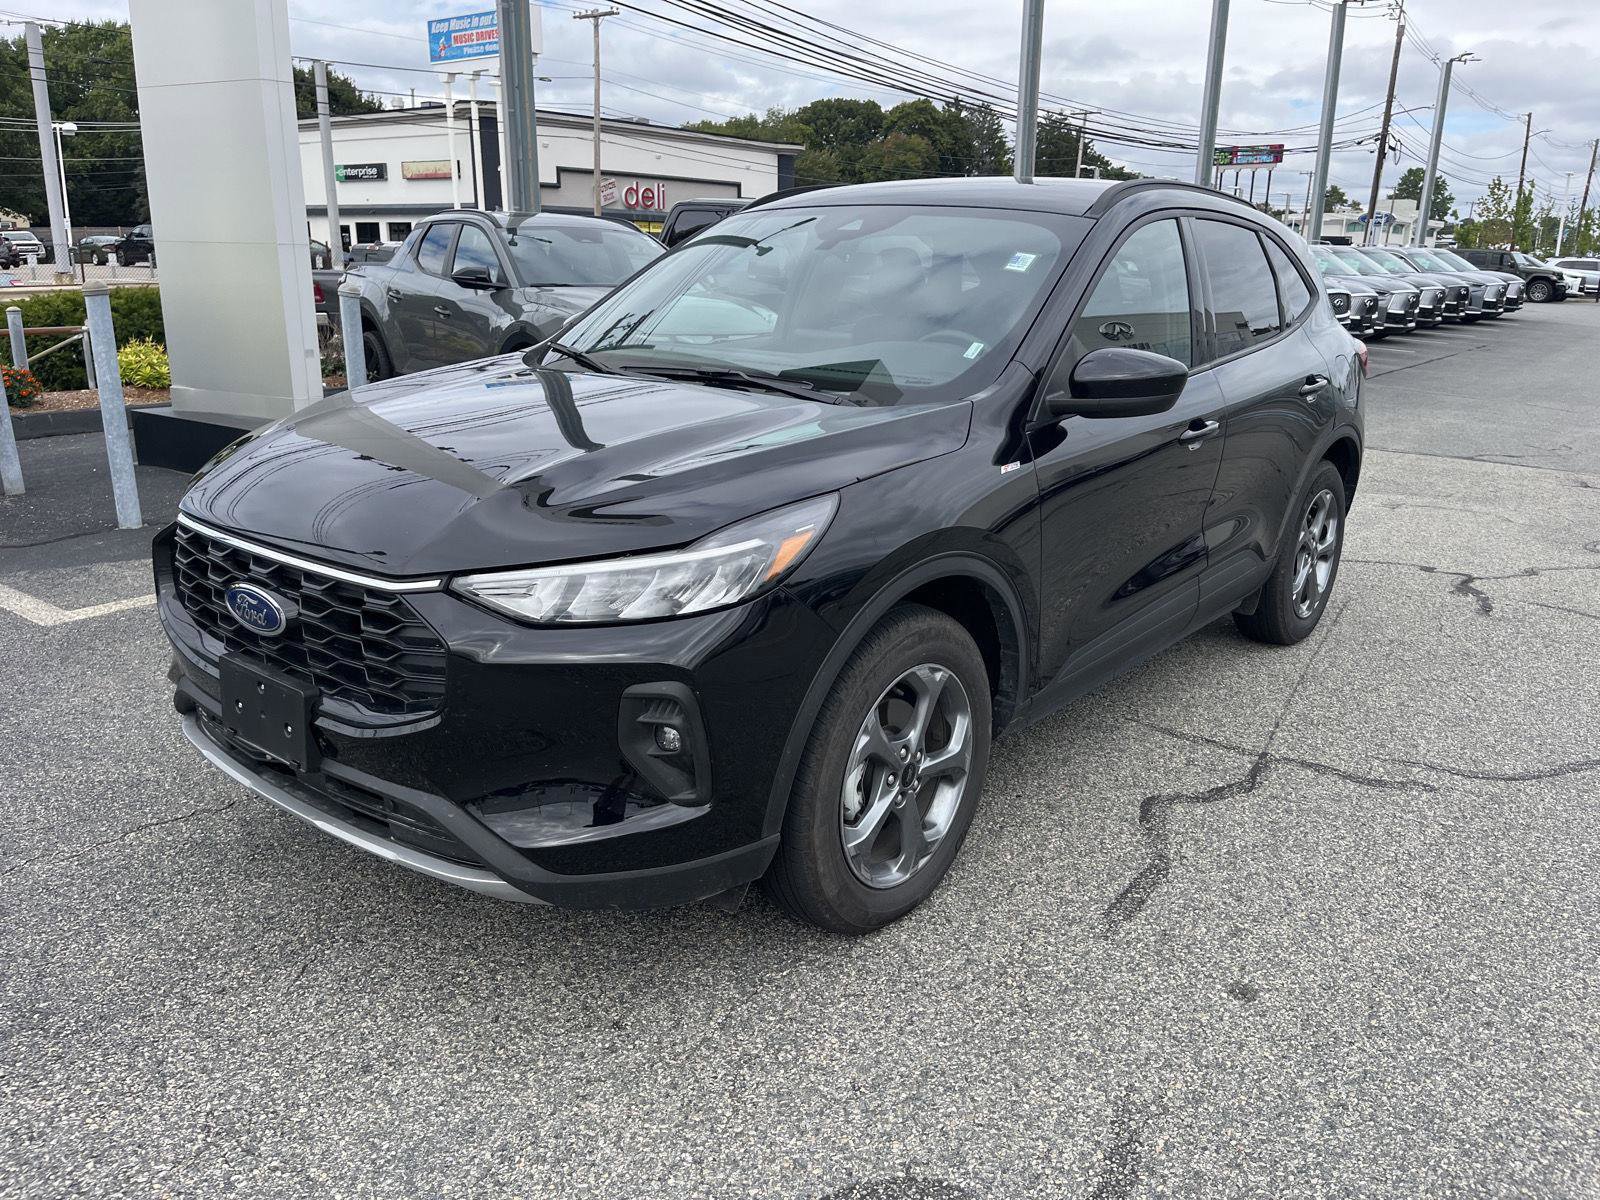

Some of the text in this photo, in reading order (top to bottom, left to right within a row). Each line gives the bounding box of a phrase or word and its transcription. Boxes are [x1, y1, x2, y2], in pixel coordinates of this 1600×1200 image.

[431, 20, 449, 33] Keep
[449, 17, 471, 30] Music
[471, 15, 480, 28] in
[480, 14, 493, 26] our
[453, 32, 475, 45] MUSIC
[337, 165, 378, 178] enterprise
[623, 181, 666, 209] deli
[235, 593, 267, 625] Ford
